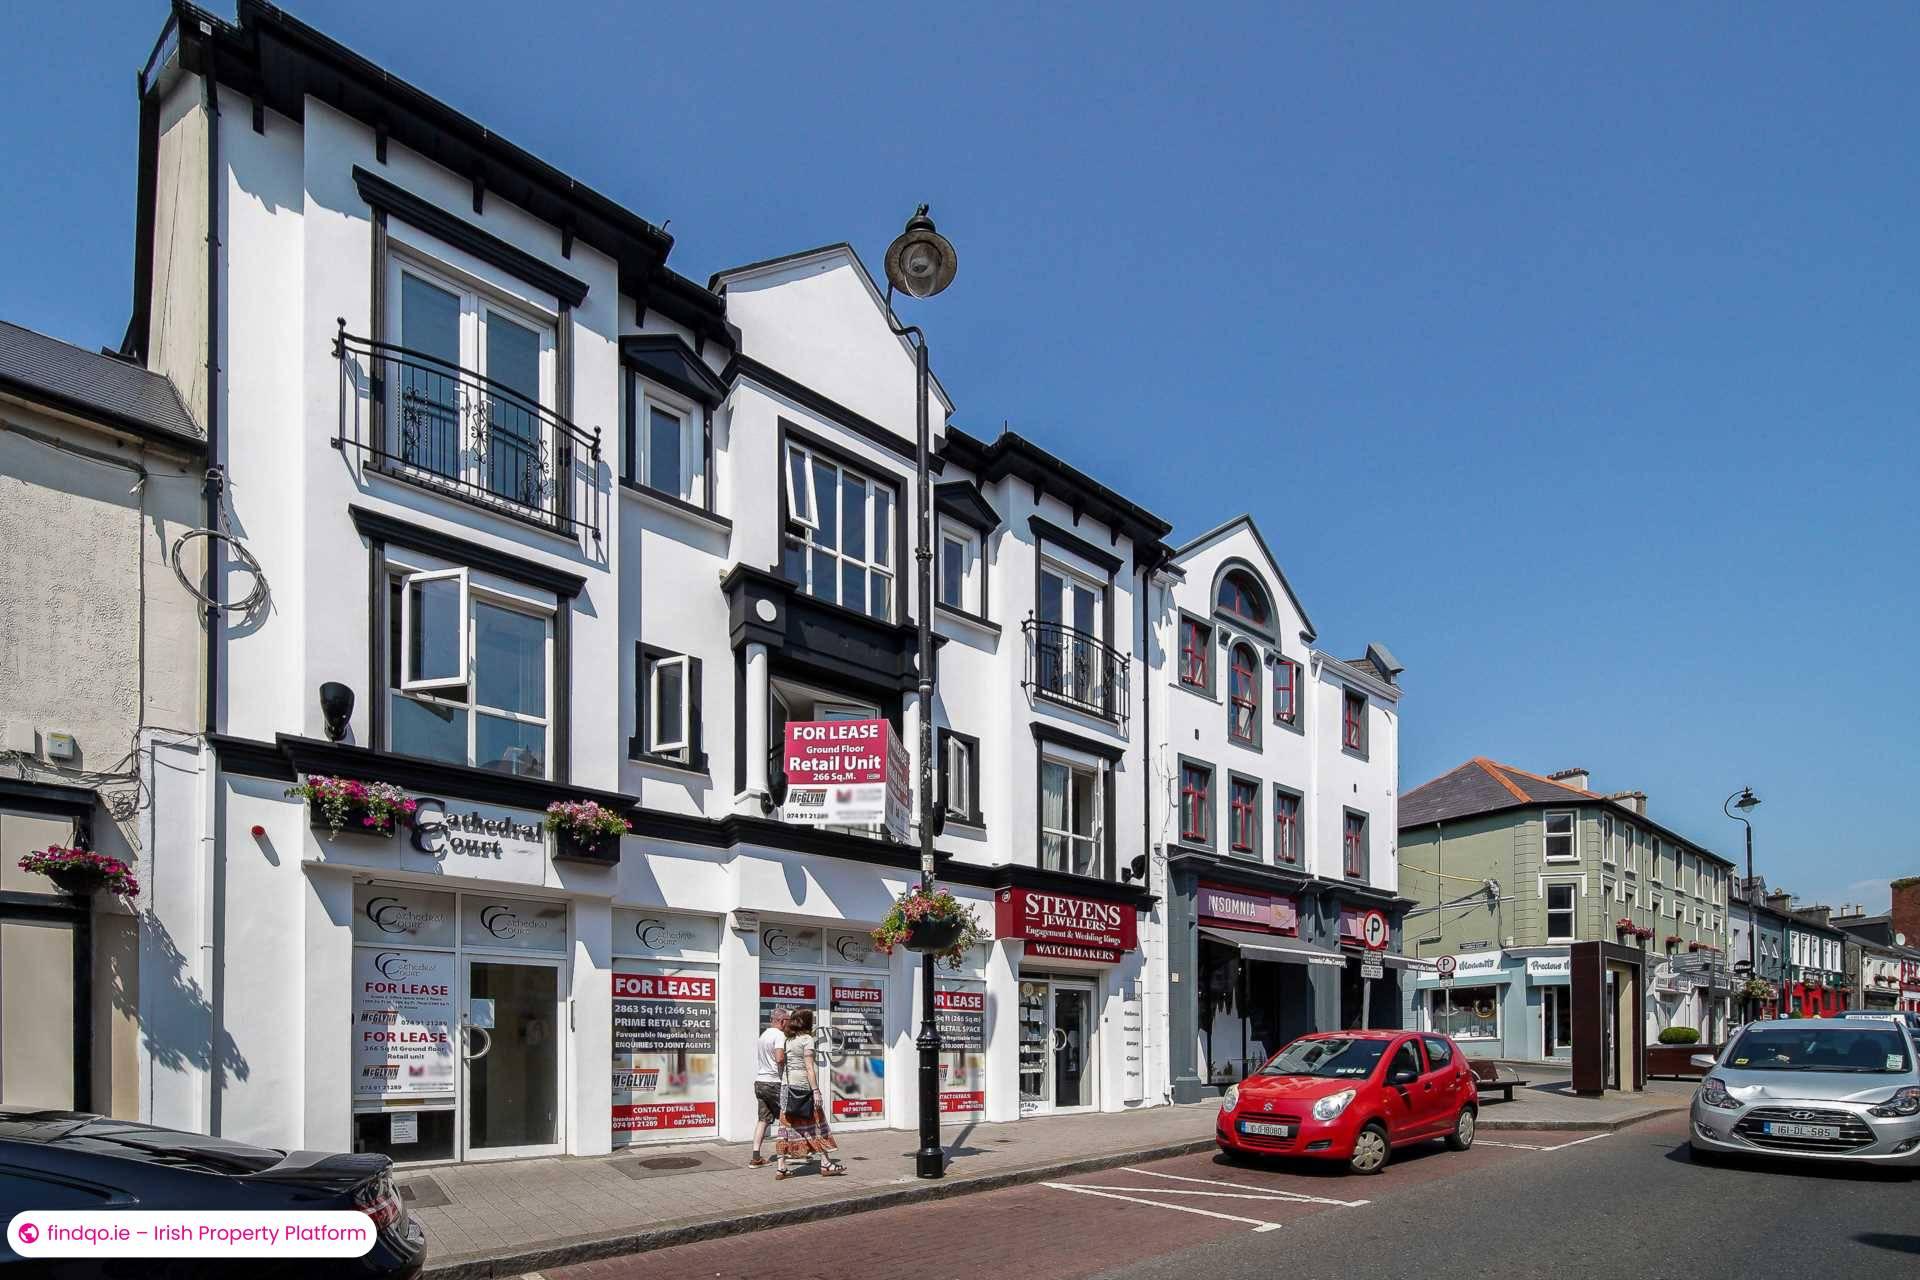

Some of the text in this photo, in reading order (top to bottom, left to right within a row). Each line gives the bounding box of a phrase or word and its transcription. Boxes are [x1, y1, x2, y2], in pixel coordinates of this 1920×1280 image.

[793, 725, 879, 740] FOR LEASE
[806, 745, 865, 754] Ground Floor
[789, 755, 881, 771] Retail Unit
[813, 773, 830, 781] 266
[831, 773, 857, 782] Sq.M.
[412, 797, 545, 843] Cathedral
[411, 823, 503, 861] Court
[1025, 893, 1121, 926] STEVENS
[1208, 894, 1256, 917] INSOMNIA
[1042, 914, 1107, 931] JEWELLERS
[1371, 917, 1380, 941] P
[1025, 925, 1066, 938] Engagement
[1067, 930, 1074, 939] &
[1075, 931, 1103, 945] Wedding
[1035, 943, 1115, 960] WATCHMAKERS
[1530, 960, 1562, 971] Precious
[365, 982, 449, 996] FOR LEASE
[615, 978, 712, 997] FOR LEASE
[772, 986, 805, 996] LEASE
[834, 989, 879, 1000] BENEFITS
[947, 995, 981, 1009] LEASE
[615, 1004, 711, 1016] 2863 Sq ft (266 Sq m)
[614, 1018, 711, 1028] PRIME RETAIL SPACE
[962, 1025, 981, 1033] SPACE
[364, 1031, 447, 1043] FOR LEASE
[657, 1031, 694, 1040] Negotiable
[427, 1045, 444, 1053] floor
[615, 1041, 653, 1049] ENQUIRIES
[654, 1041, 664, 1049] TO
[612, 1073, 658, 1087] McGLYNN
[633, 1106, 665, 1114] CONTACT
[1777, 1125, 1831, 1137] 161-DL-585
